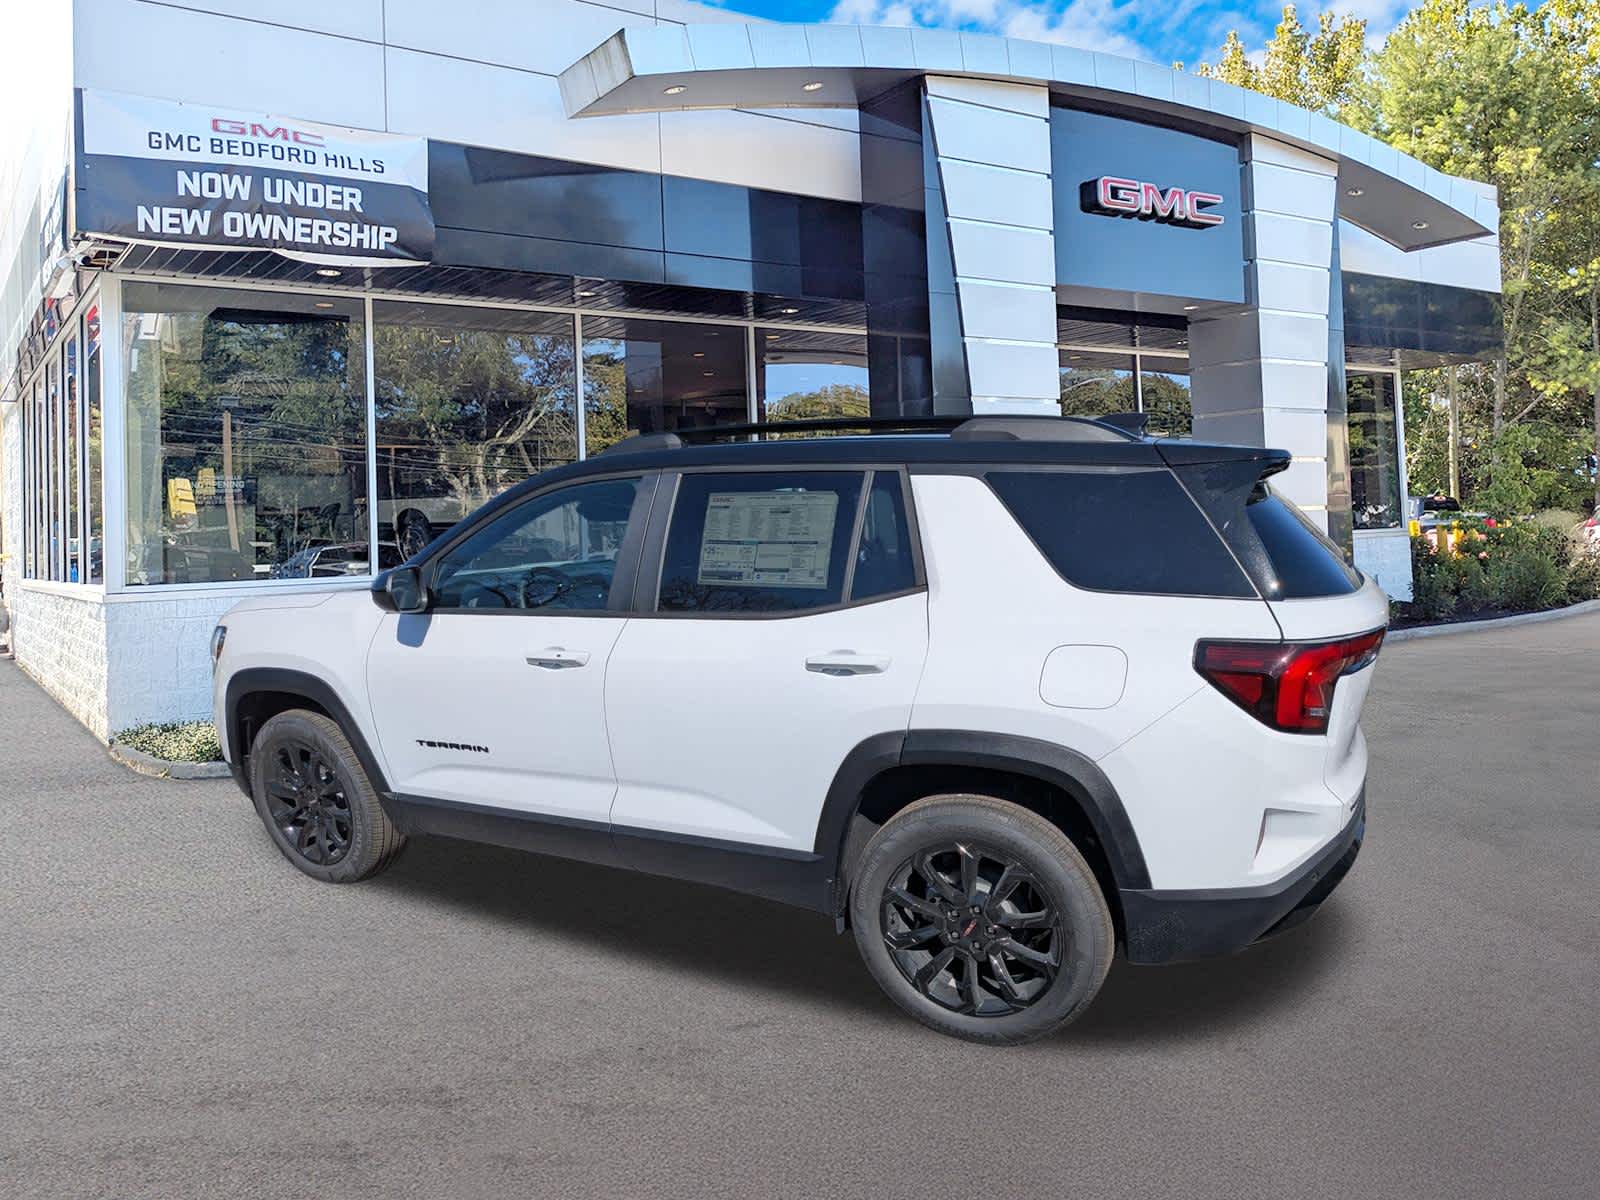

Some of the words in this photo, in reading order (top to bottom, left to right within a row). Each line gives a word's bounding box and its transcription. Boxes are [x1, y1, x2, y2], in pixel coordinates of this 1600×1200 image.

[148, 131, 201, 152] GMC
[210, 137, 316, 165] BEDFORD
[324, 152, 385, 174] HILLS
[211, 118, 325, 147] GMC
[177, 170, 252, 201] NOW
[263, 176, 363, 213] UNDER
[1096, 175, 1225, 226] GMC
[136, 205, 211, 236] NEW
[223, 210, 398, 250] OWNERSHIP
[415, 739, 490, 753] TERRAIN
